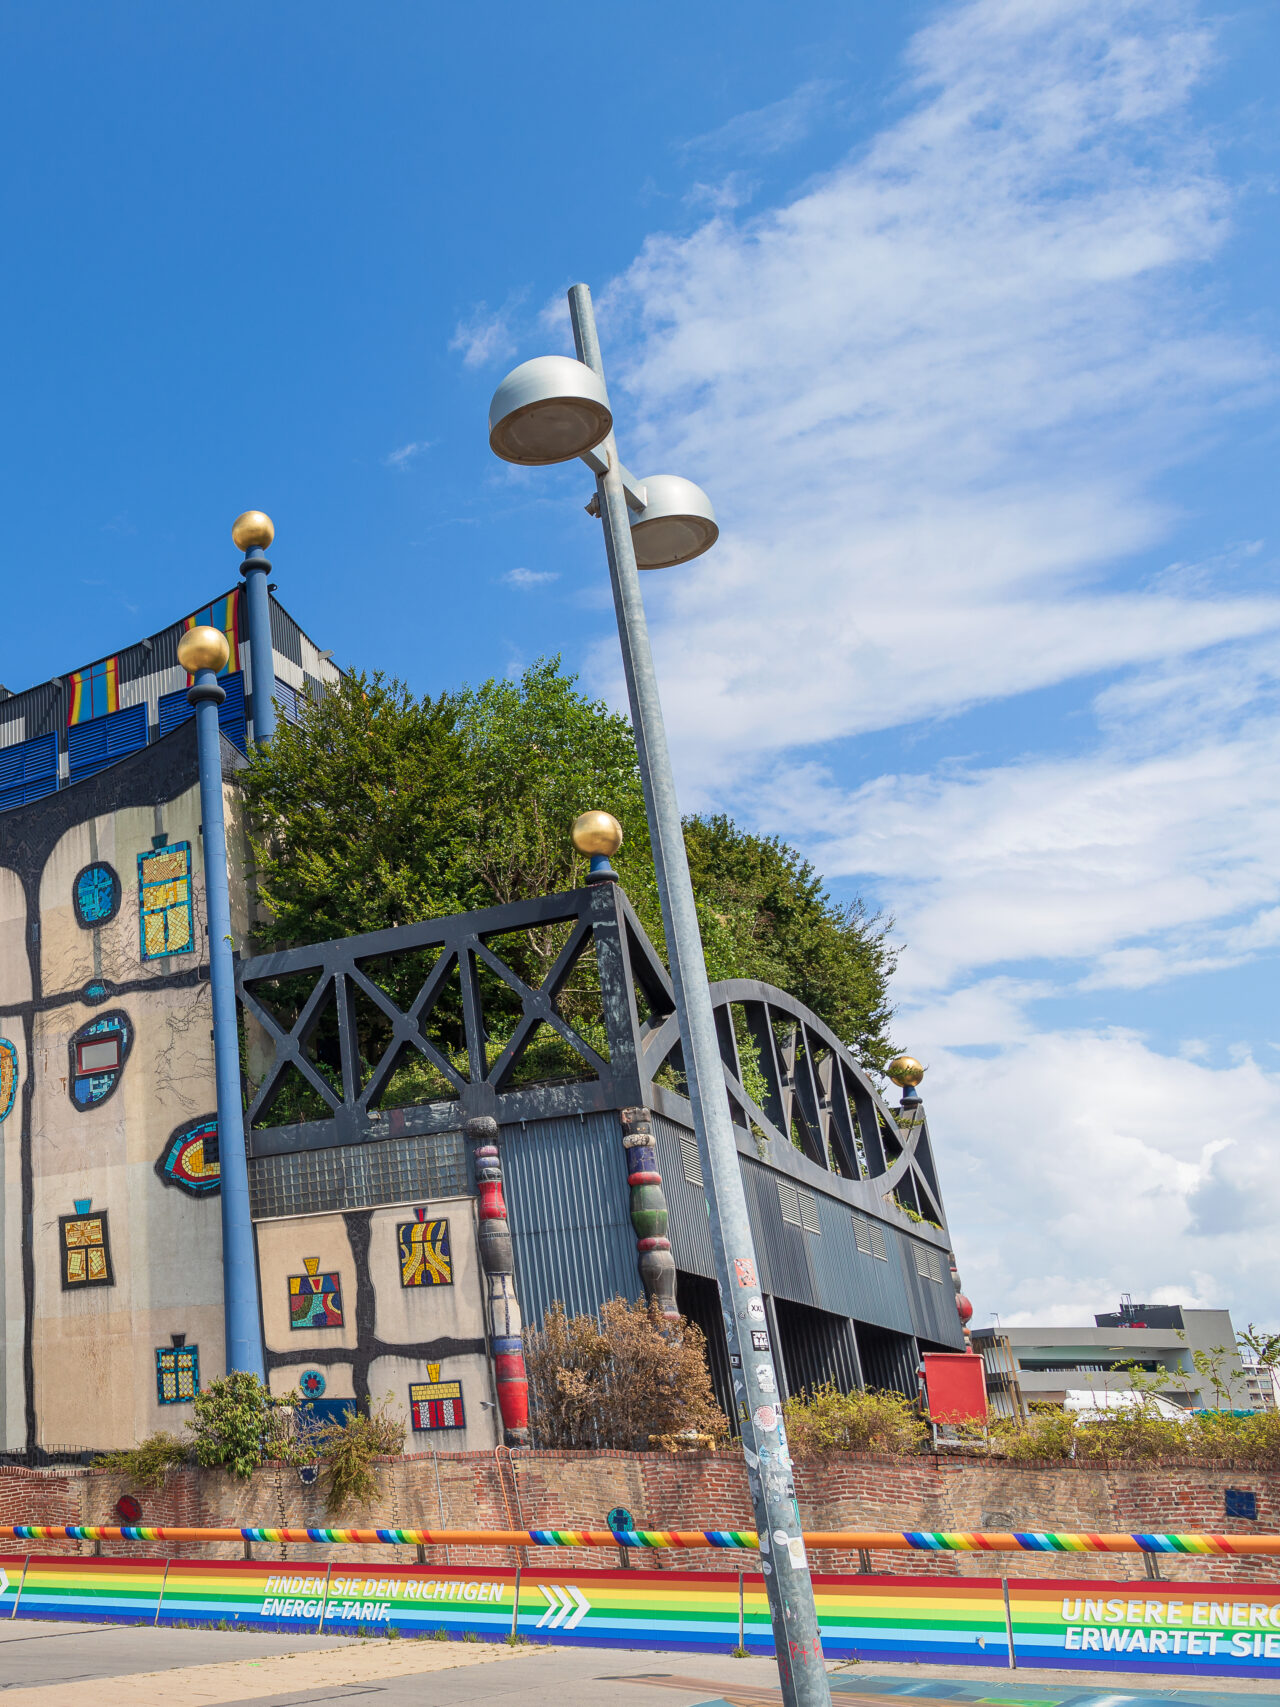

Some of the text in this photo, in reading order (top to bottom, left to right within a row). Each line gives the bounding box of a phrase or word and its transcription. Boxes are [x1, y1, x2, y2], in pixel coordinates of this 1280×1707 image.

[264, 1575, 504, 1602] FINDEN SIE DEN RICHTIGEN
[1061, 1598, 1184, 1625] UNSERE
[1064, 1626, 1280, 1659] ERWARTET SIE
